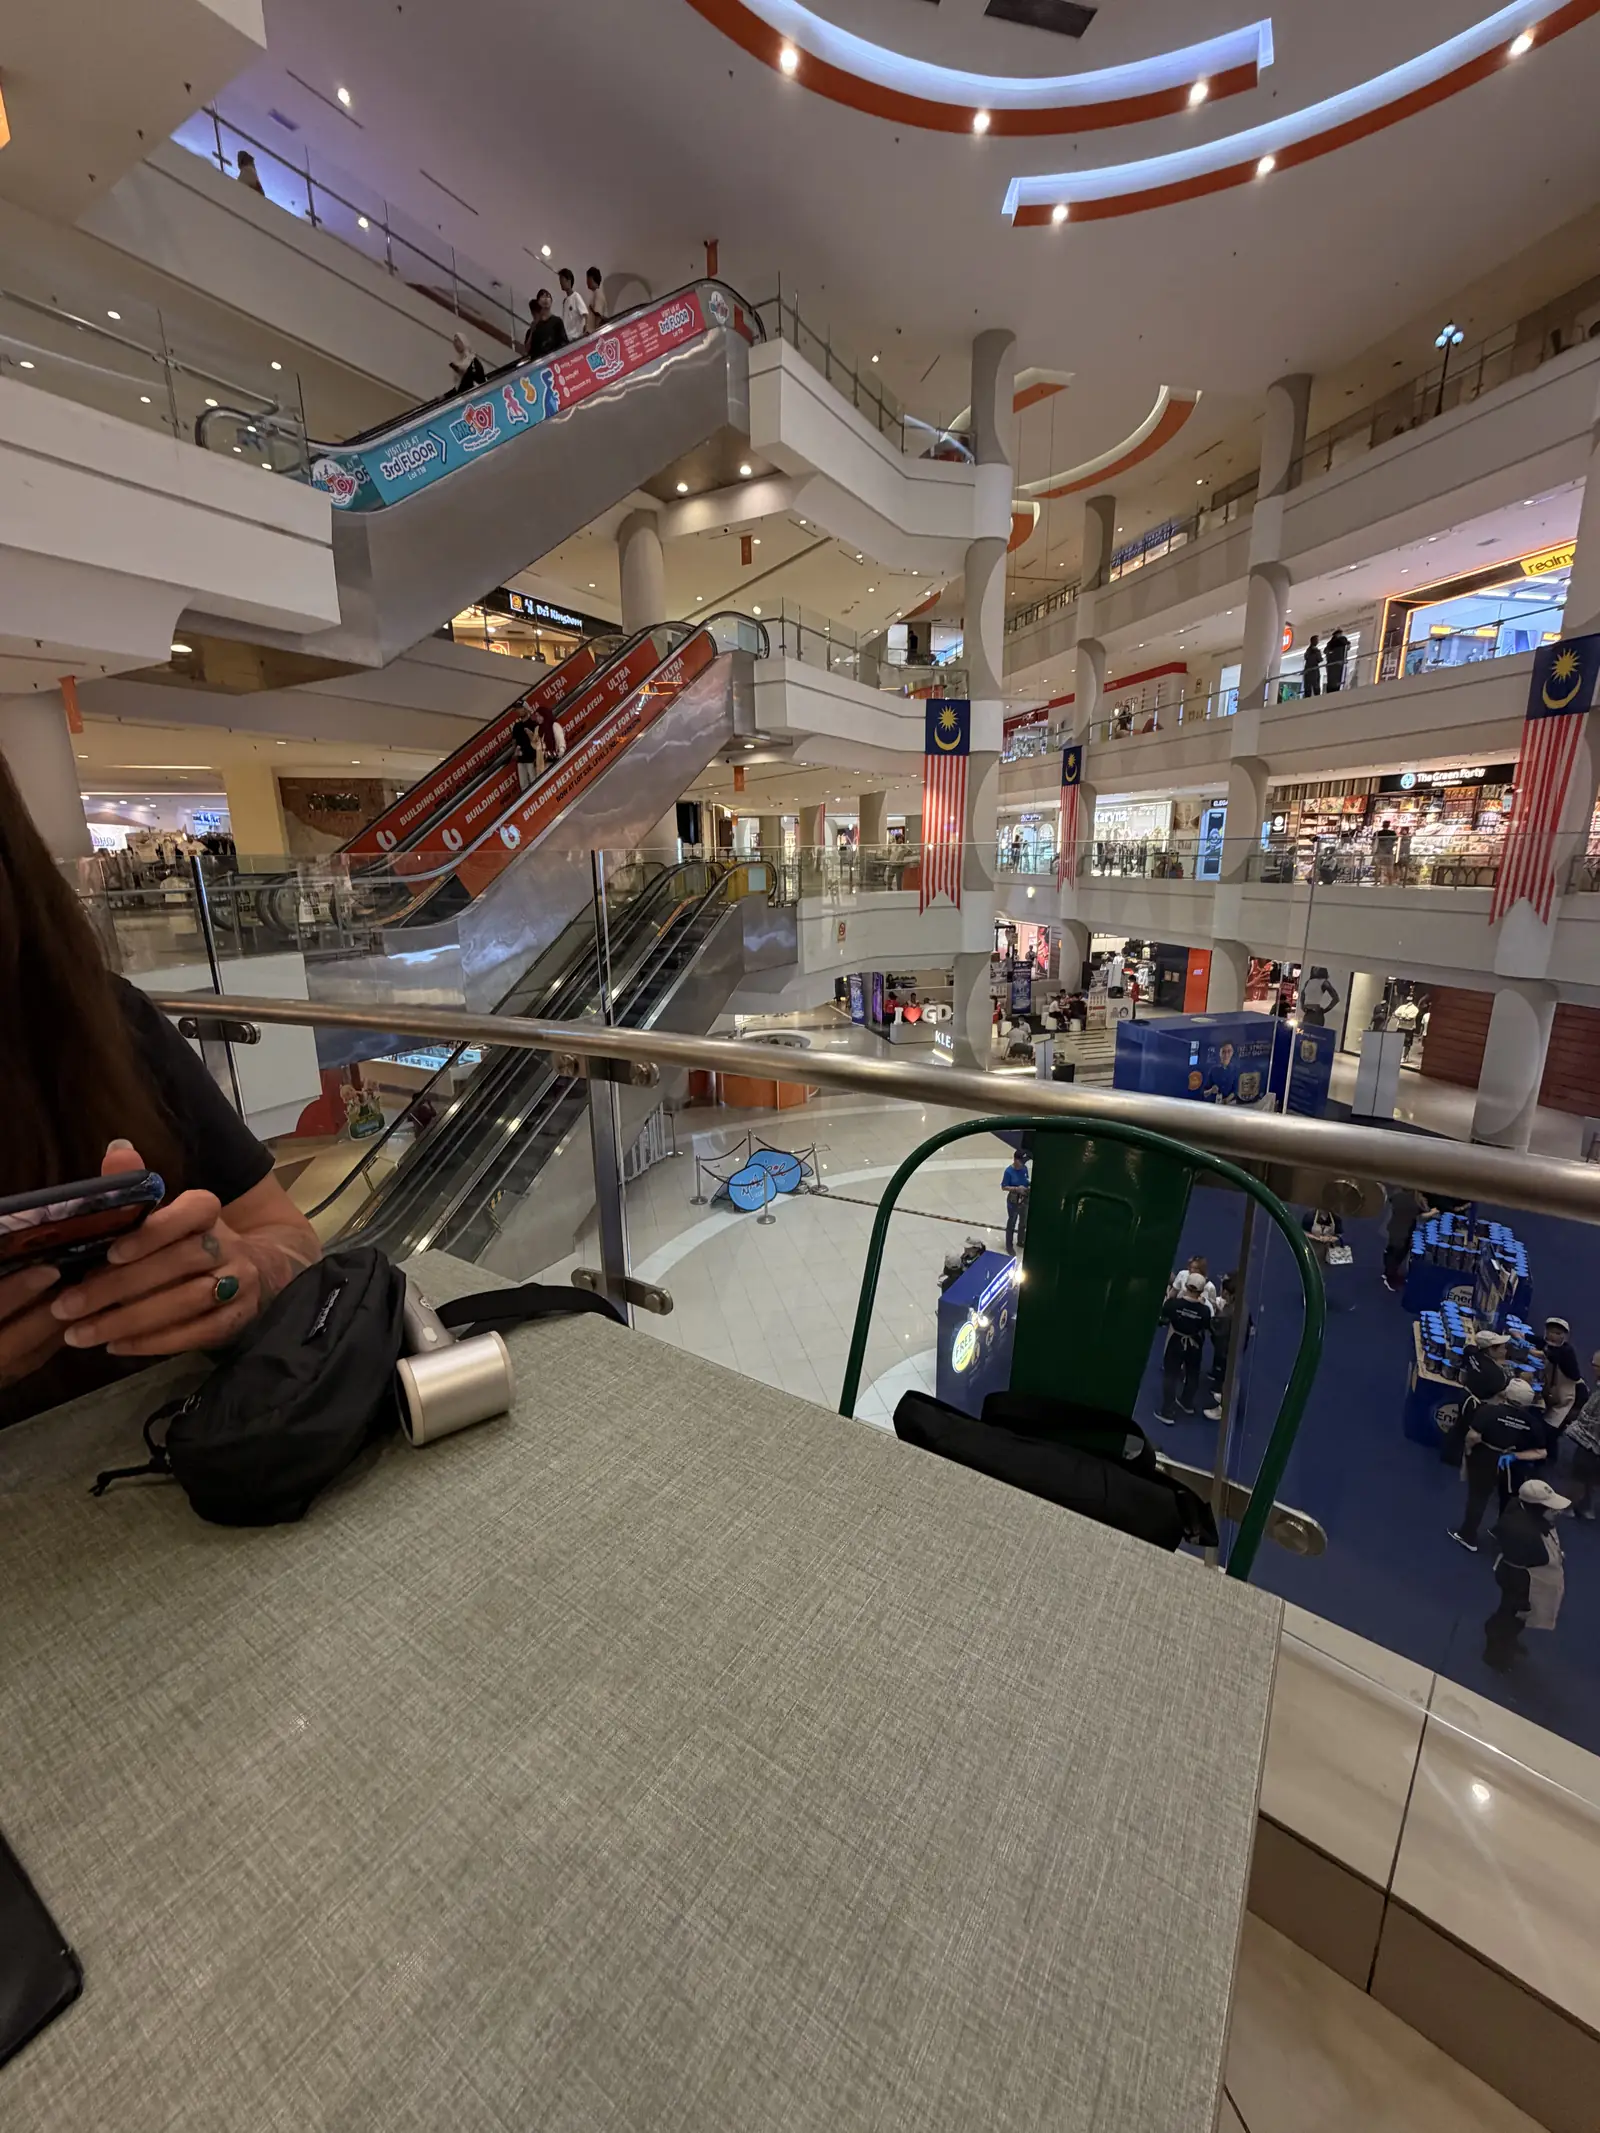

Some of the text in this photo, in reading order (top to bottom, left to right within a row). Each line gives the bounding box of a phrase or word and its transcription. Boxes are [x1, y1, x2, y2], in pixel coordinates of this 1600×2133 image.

[669, 309, 689, 329] FLOOR
[385, 435, 420, 458] VISIT US AT
[381, 461, 402, 479] 3rd
[401, 446, 435, 471] FLOOR
[550, 608, 582, 628] Kingdom
[607, 666, 632, 691] ULTRA
[661, 657, 685, 682] ULTRA
[543, 676, 568, 700] ULTRA
[555, 690, 566, 703] 5G
[618, 682, 629, 695] 5G
[465, 693, 604, 824] BUILDING NEXT FOR MALAYSIA
[522, 784, 557, 821] BUILDING
[555, 766, 575, 789] NEXT
[574, 755, 589, 771] GEN
[587, 726, 618, 757] NETWORK
[617, 713, 631, 726] FOR
[400, 791, 435, 827] BUILDING
[433, 776, 454, 797] NEXT
[452, 765, 467, 781] GEN
[466, 738, 498, 770] NETWORK
[497, 727, 512, 742] FOR
[1417, 768, 1486, 782] The Green Party
[894, 1004, 951, 1025] I GD
[935, 1030, 953, 1049] KLE
[955, 1329, 973, 1358] FREE
